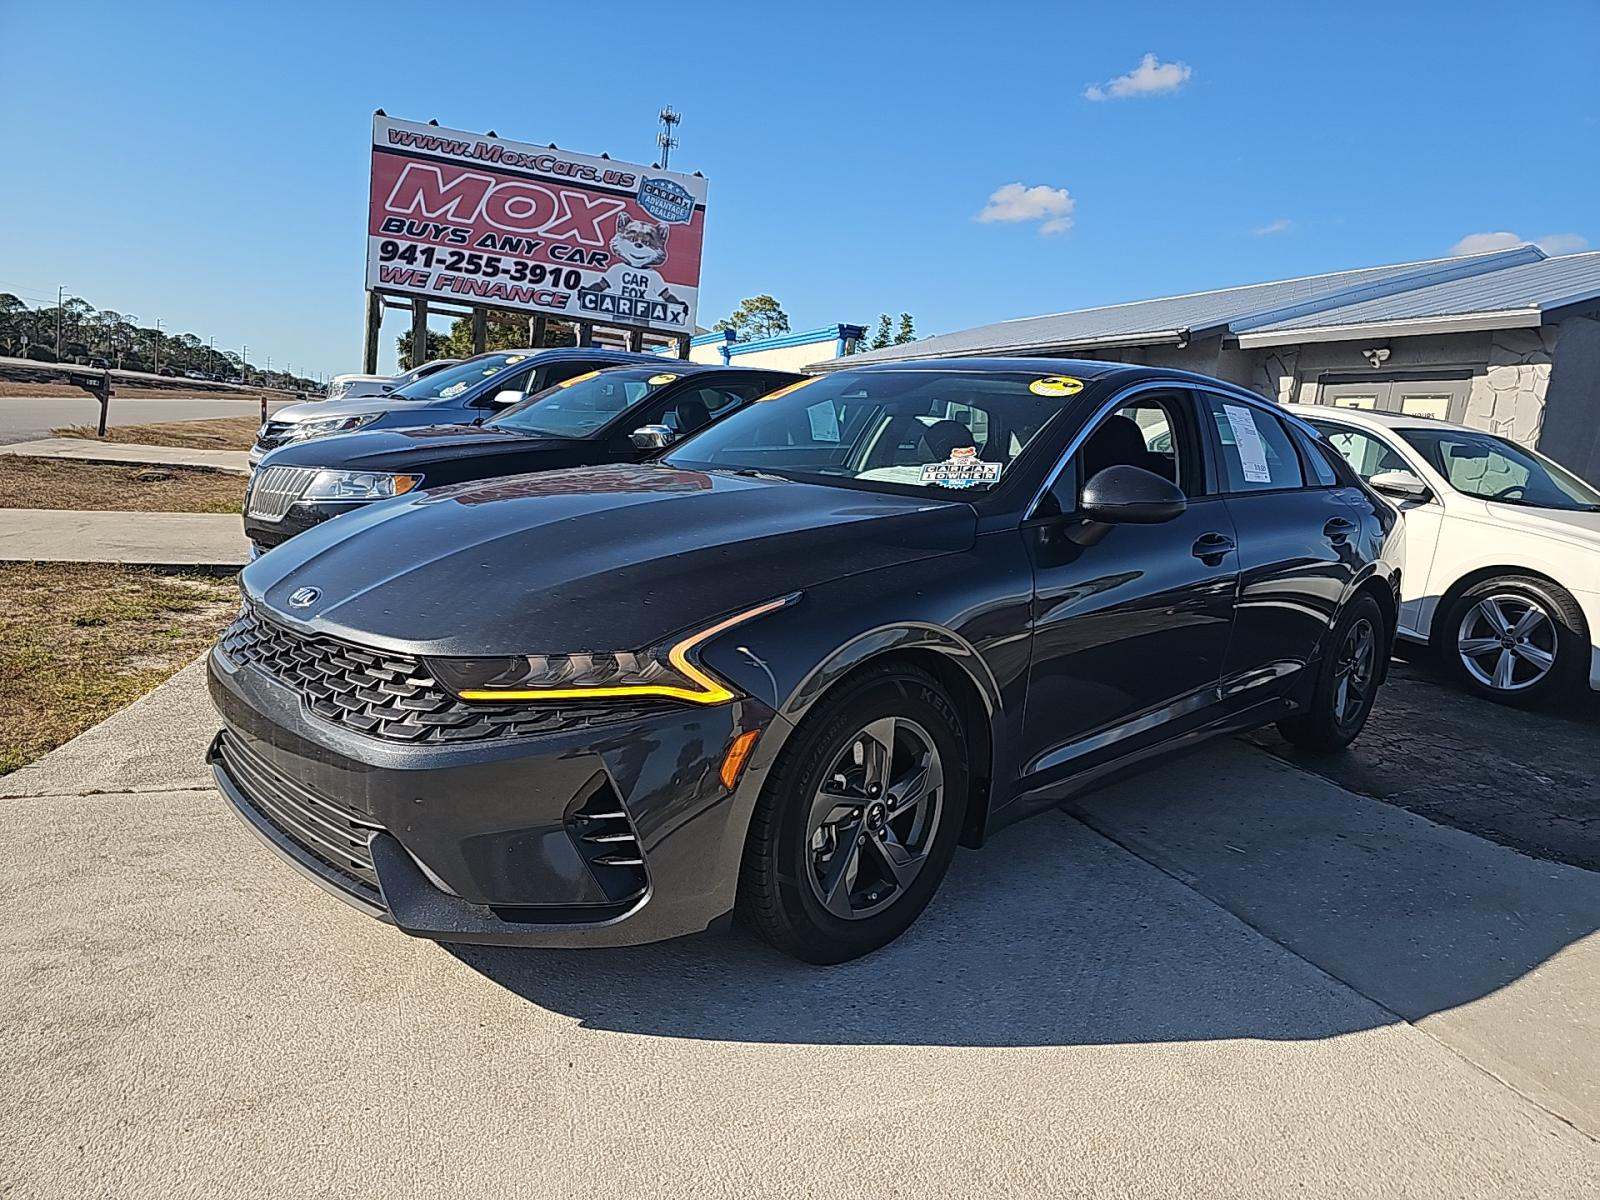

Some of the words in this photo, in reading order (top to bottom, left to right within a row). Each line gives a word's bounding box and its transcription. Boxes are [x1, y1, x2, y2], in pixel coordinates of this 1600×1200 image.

[388, 128, 637, 188] www.MoxCars.us
[385, 162, 627, 247] MOX
[645, 184, 690, 209] CARFAX
[645, 195, 686, 216] ADVANTAGE
[650, 205, 677, 221] DEALER
[380, 217, 472, 245] BUYS
[475, 232, 543, 256] ANY
[549, 244, 611, 268] CAR
[379, 240, 582, 290] 941-255-3910
[379, 265, 430, 288] WE
[433, 272, 572, 309] FINANCE
[621, 272, 649, 289] CAR
[621, 285, 647, 300] FOX
[582, 293, 683, 324] CARFAX
[925, 465, 995, 473] CARFAX
[935, 472, 996, 480] OWNER
